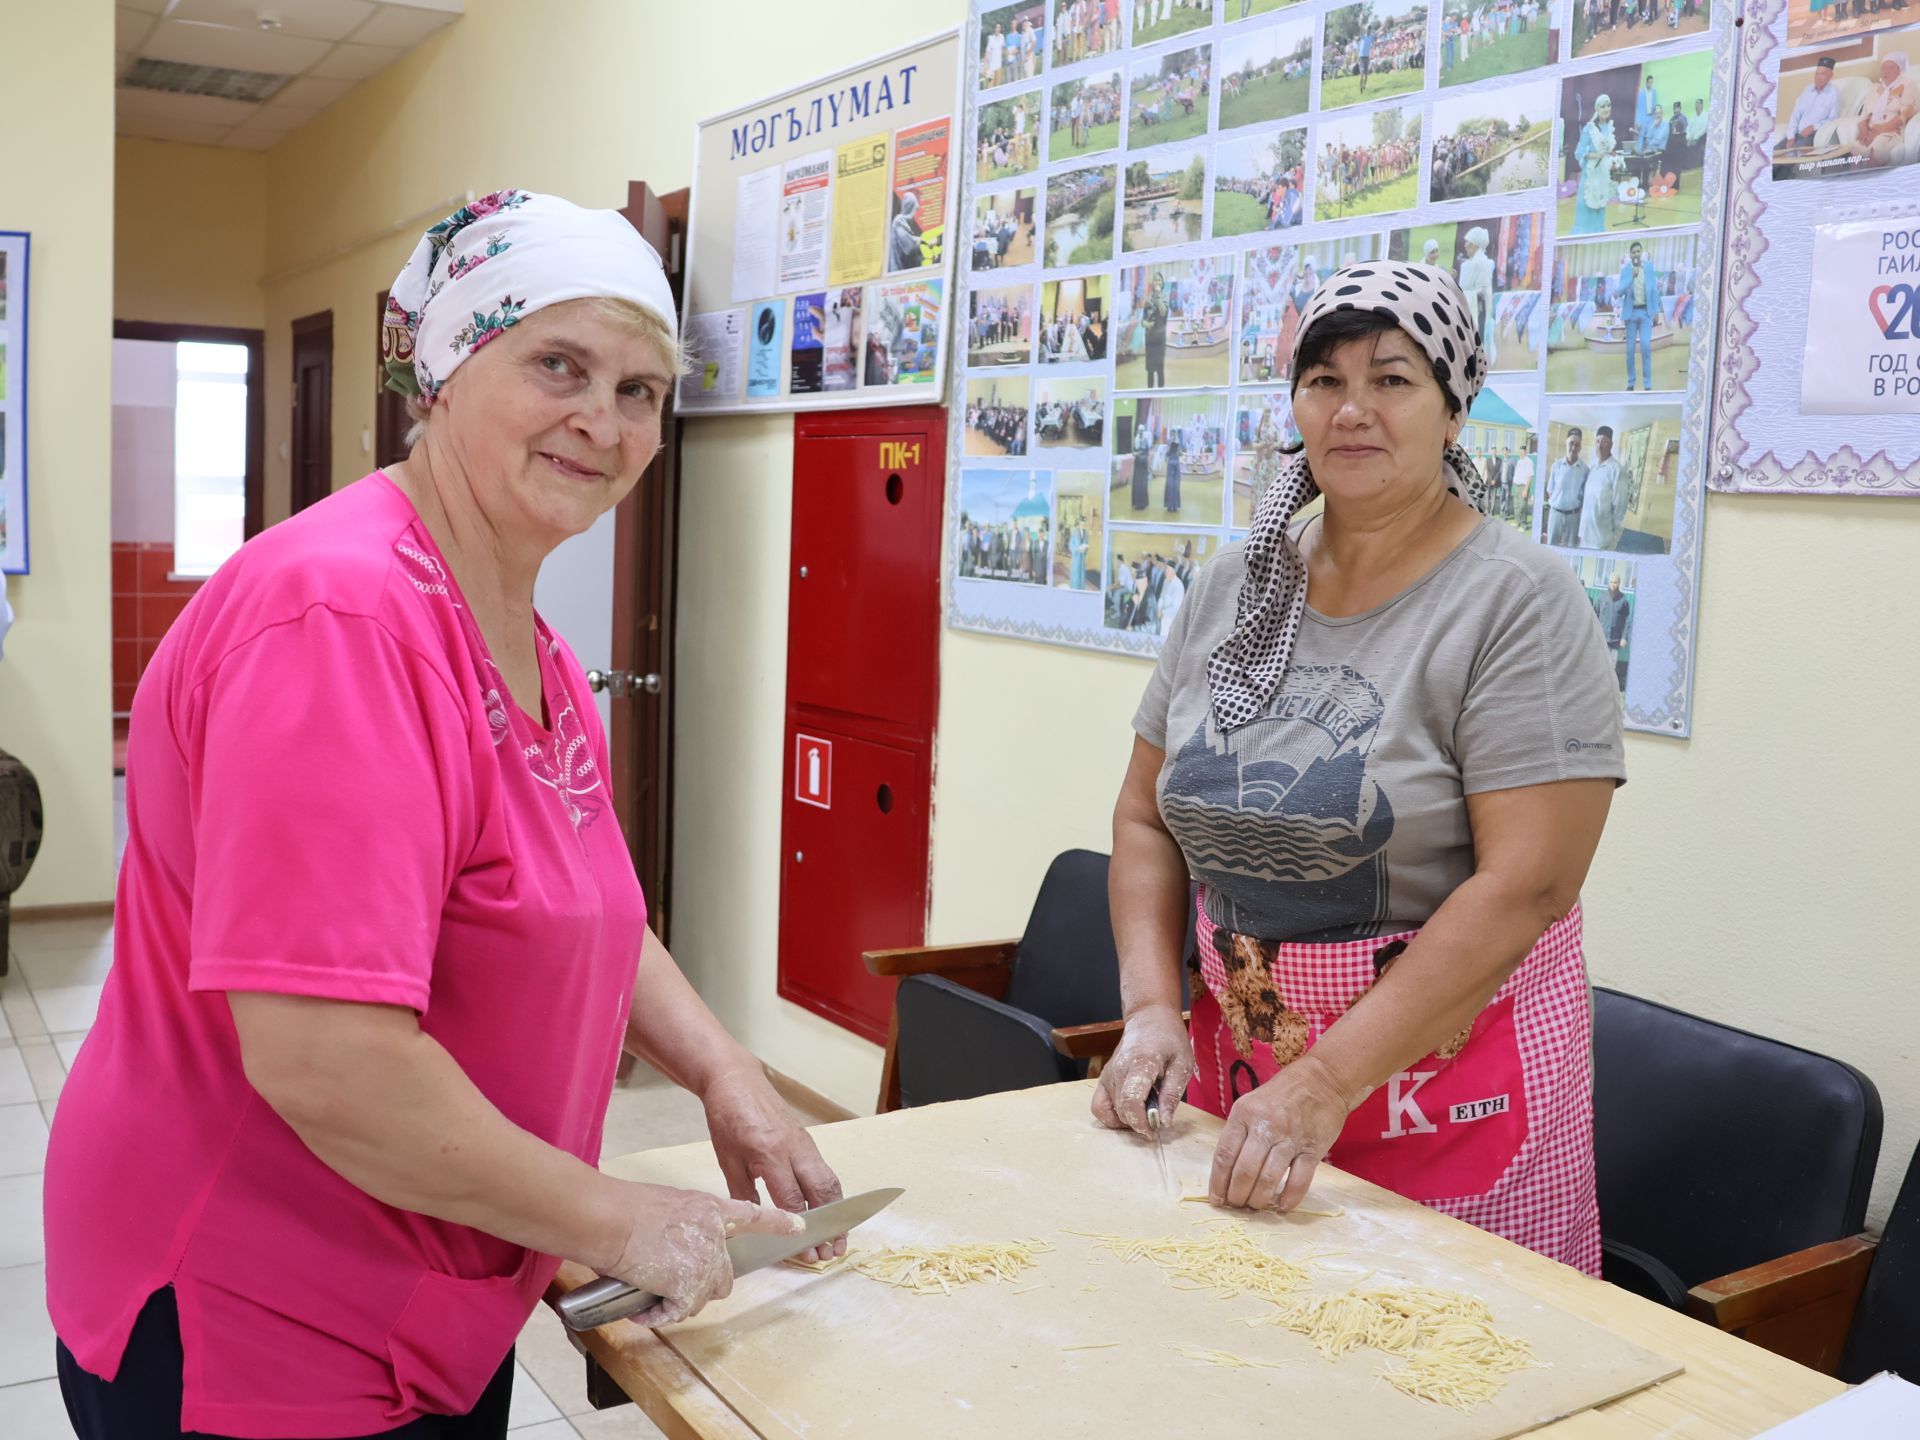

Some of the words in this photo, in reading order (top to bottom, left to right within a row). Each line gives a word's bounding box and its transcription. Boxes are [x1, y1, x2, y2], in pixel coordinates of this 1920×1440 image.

[730, 65, 917, 160] МӘГЪЛҮМАТ
[1869, 354, 1908, 375] ГОД
[1874, 378, 1886, 396] В
[880, 441, 920, 469] ПК-1
[1455, 1097, 1505, 1120] EITH
